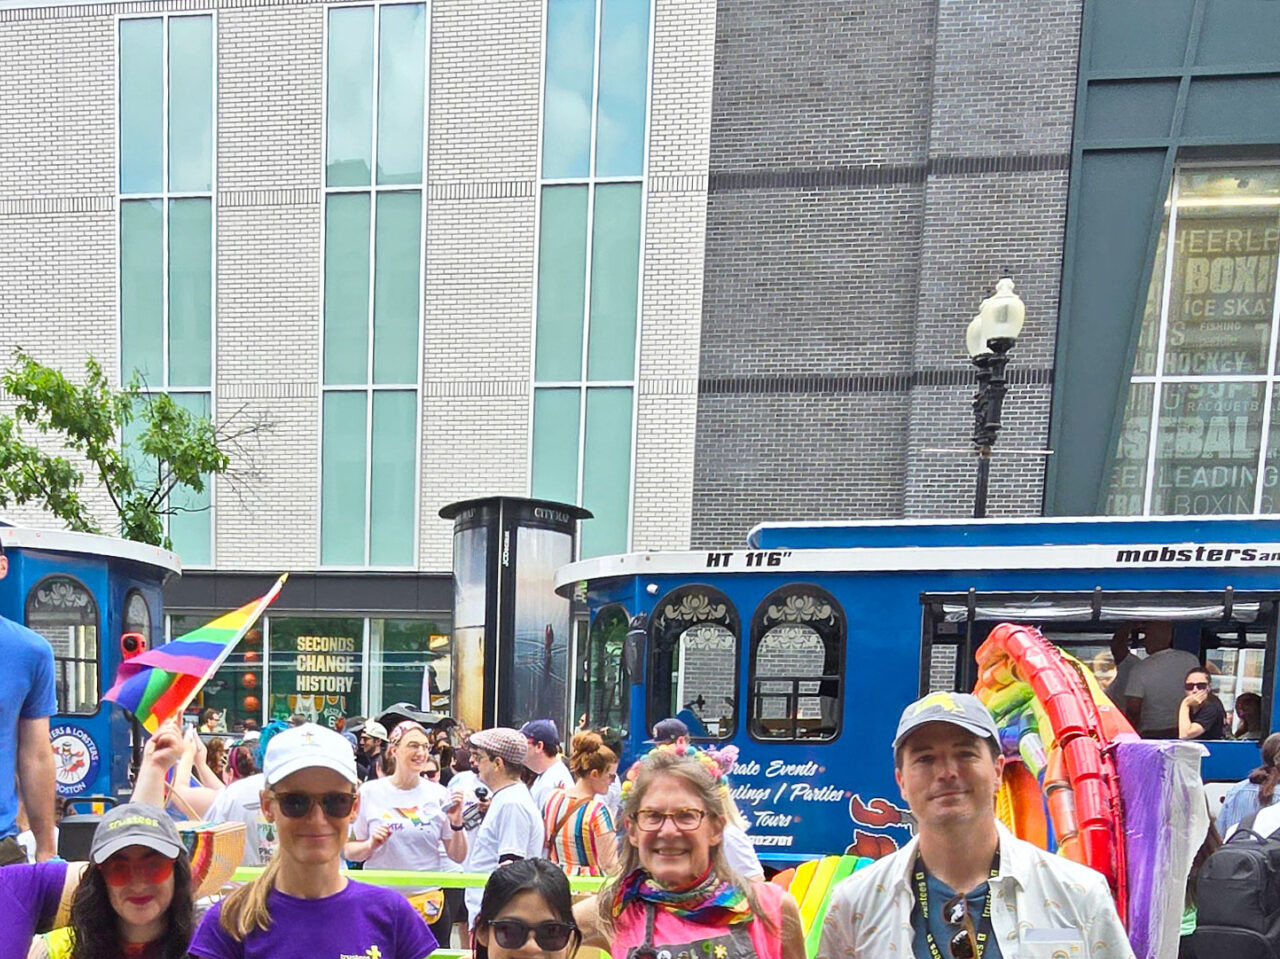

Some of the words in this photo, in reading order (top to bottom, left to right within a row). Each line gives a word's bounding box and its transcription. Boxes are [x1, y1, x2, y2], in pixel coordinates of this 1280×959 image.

[1184, 299, 1215, 316] ICE
[1223, 298, 1271, 316] SKA
[534, 507, 555, 520] CITY
[706, 552, 733, 567] HT
[297, 636, 355, 651] SECONDS
[296, 655, 355, 673] CHANGE
[296, 675, 355, 692] HISTORY
[765, 760, 818, 778] Events
[790, 783, 845, 802] Parties
[753, 810, 792, 827] Tours
